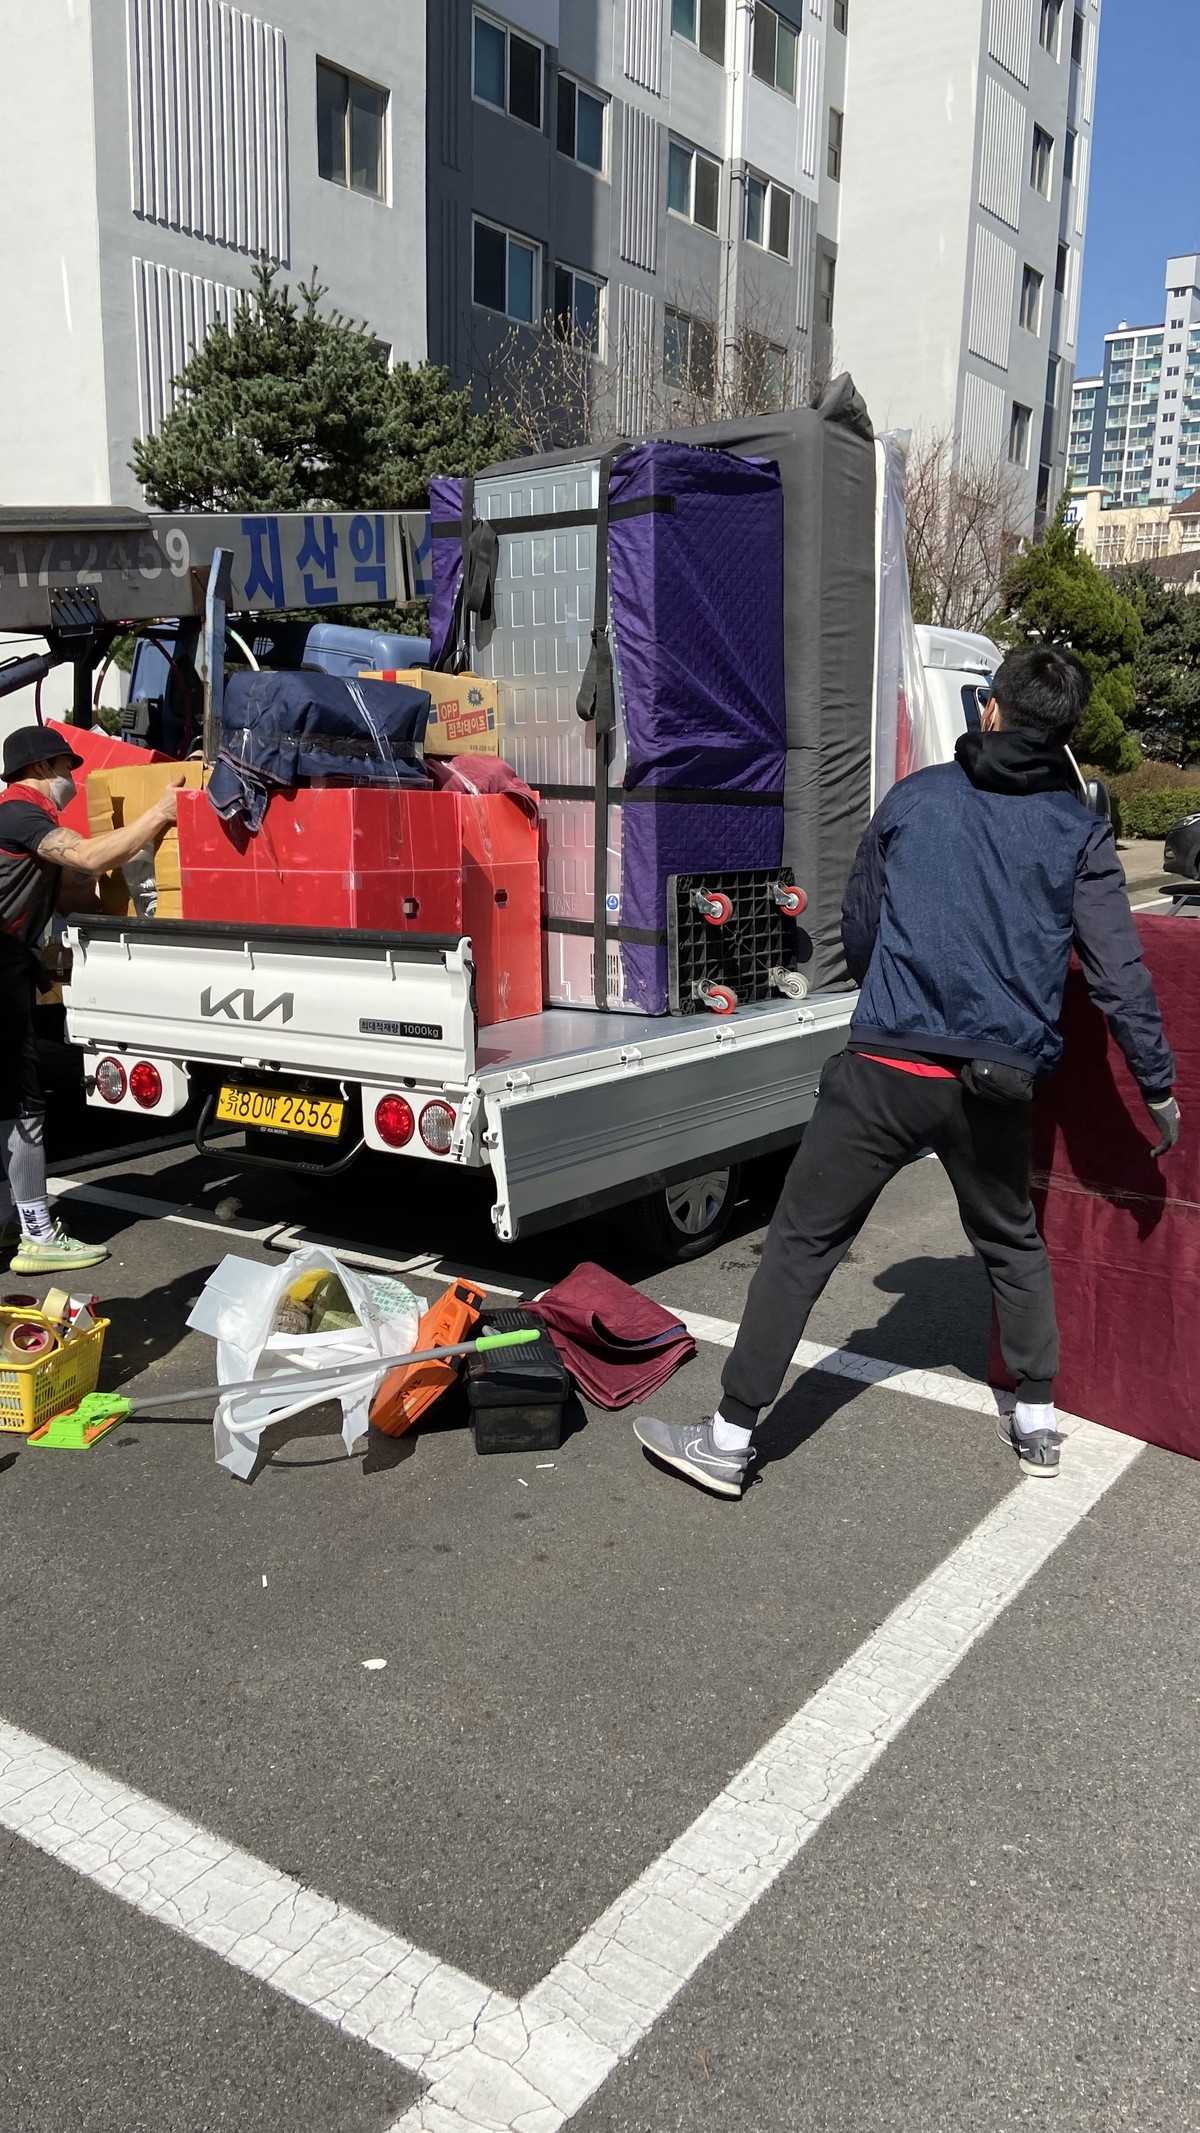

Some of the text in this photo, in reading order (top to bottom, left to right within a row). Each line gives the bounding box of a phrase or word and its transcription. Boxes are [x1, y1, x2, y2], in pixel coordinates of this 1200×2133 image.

[0, 528, 190, 588] 17-2459
[440, 702, 458, 720] OPP
[361, 1020, 439, 1038] 최대적재량 1000kg
[280, 1097, 333, 1130] 2656
